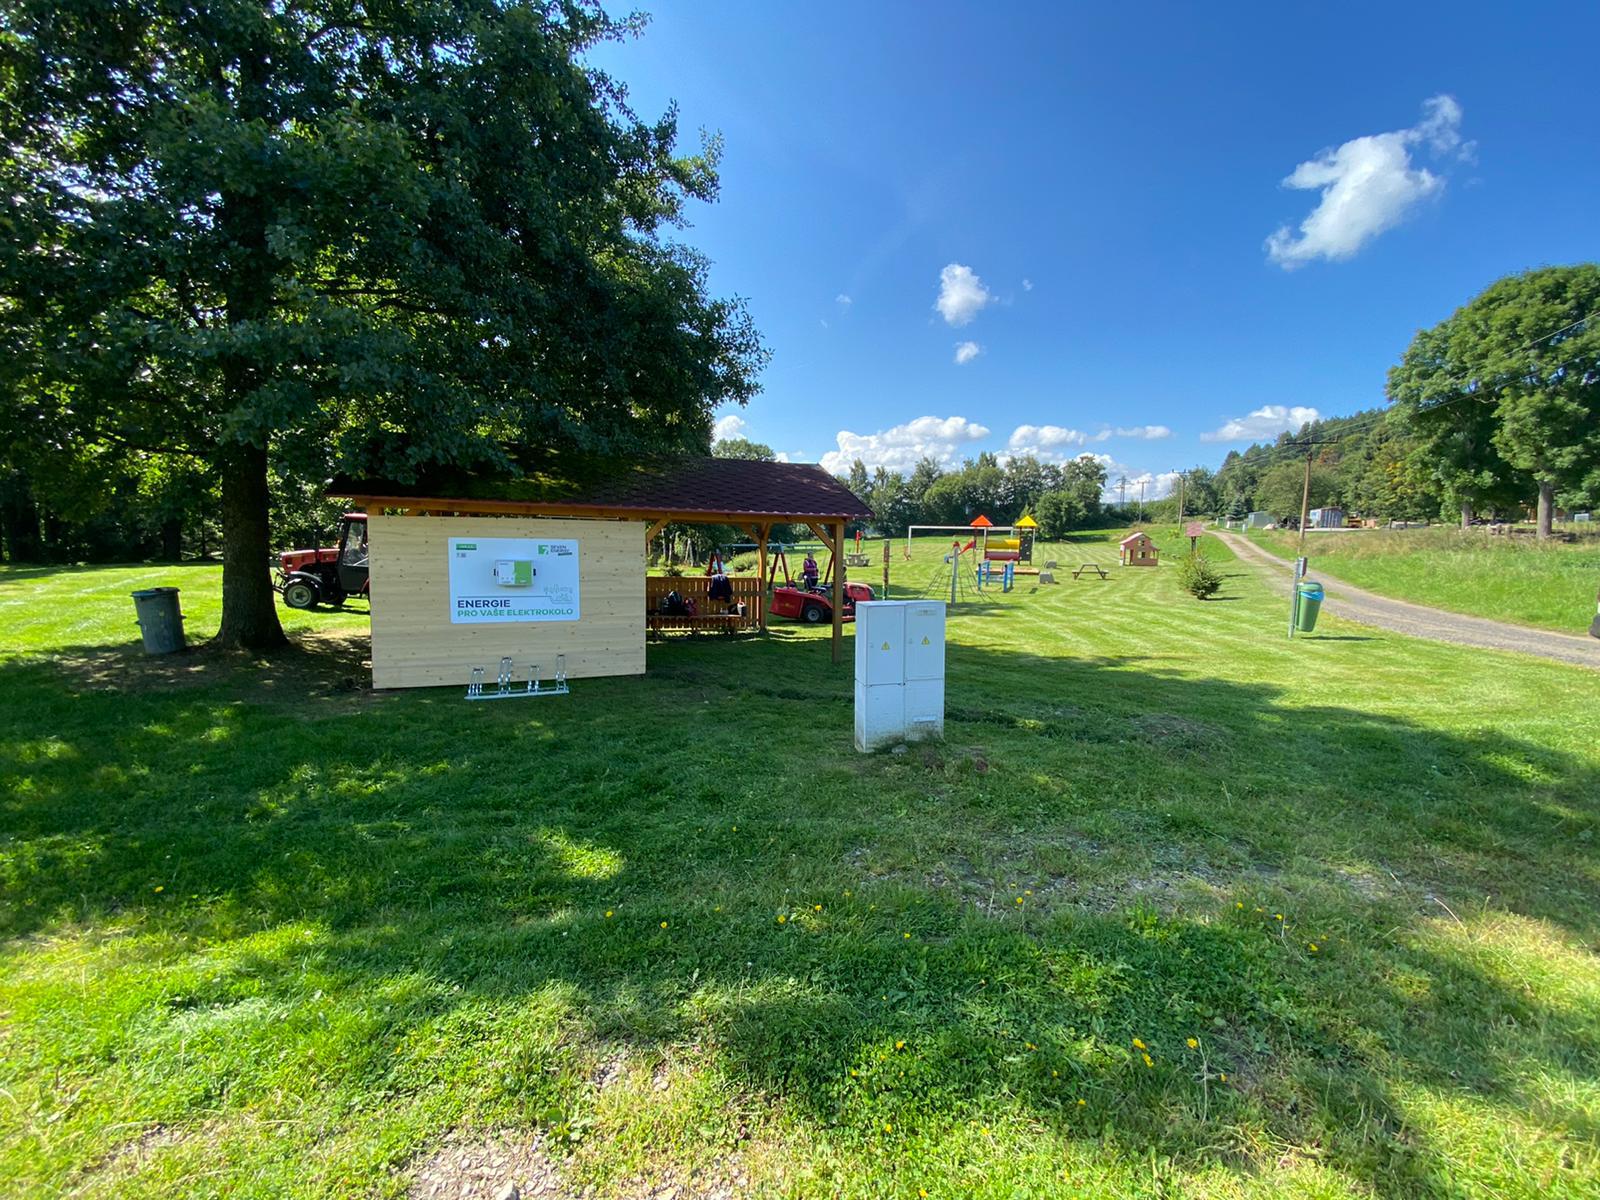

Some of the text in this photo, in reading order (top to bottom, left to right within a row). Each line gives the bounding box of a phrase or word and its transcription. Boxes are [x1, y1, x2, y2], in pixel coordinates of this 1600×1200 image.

[457, 599, 511, 608] ENERGIE
[457, 608, 574, 617] PRO VAŠE ELEKTROKOLO
